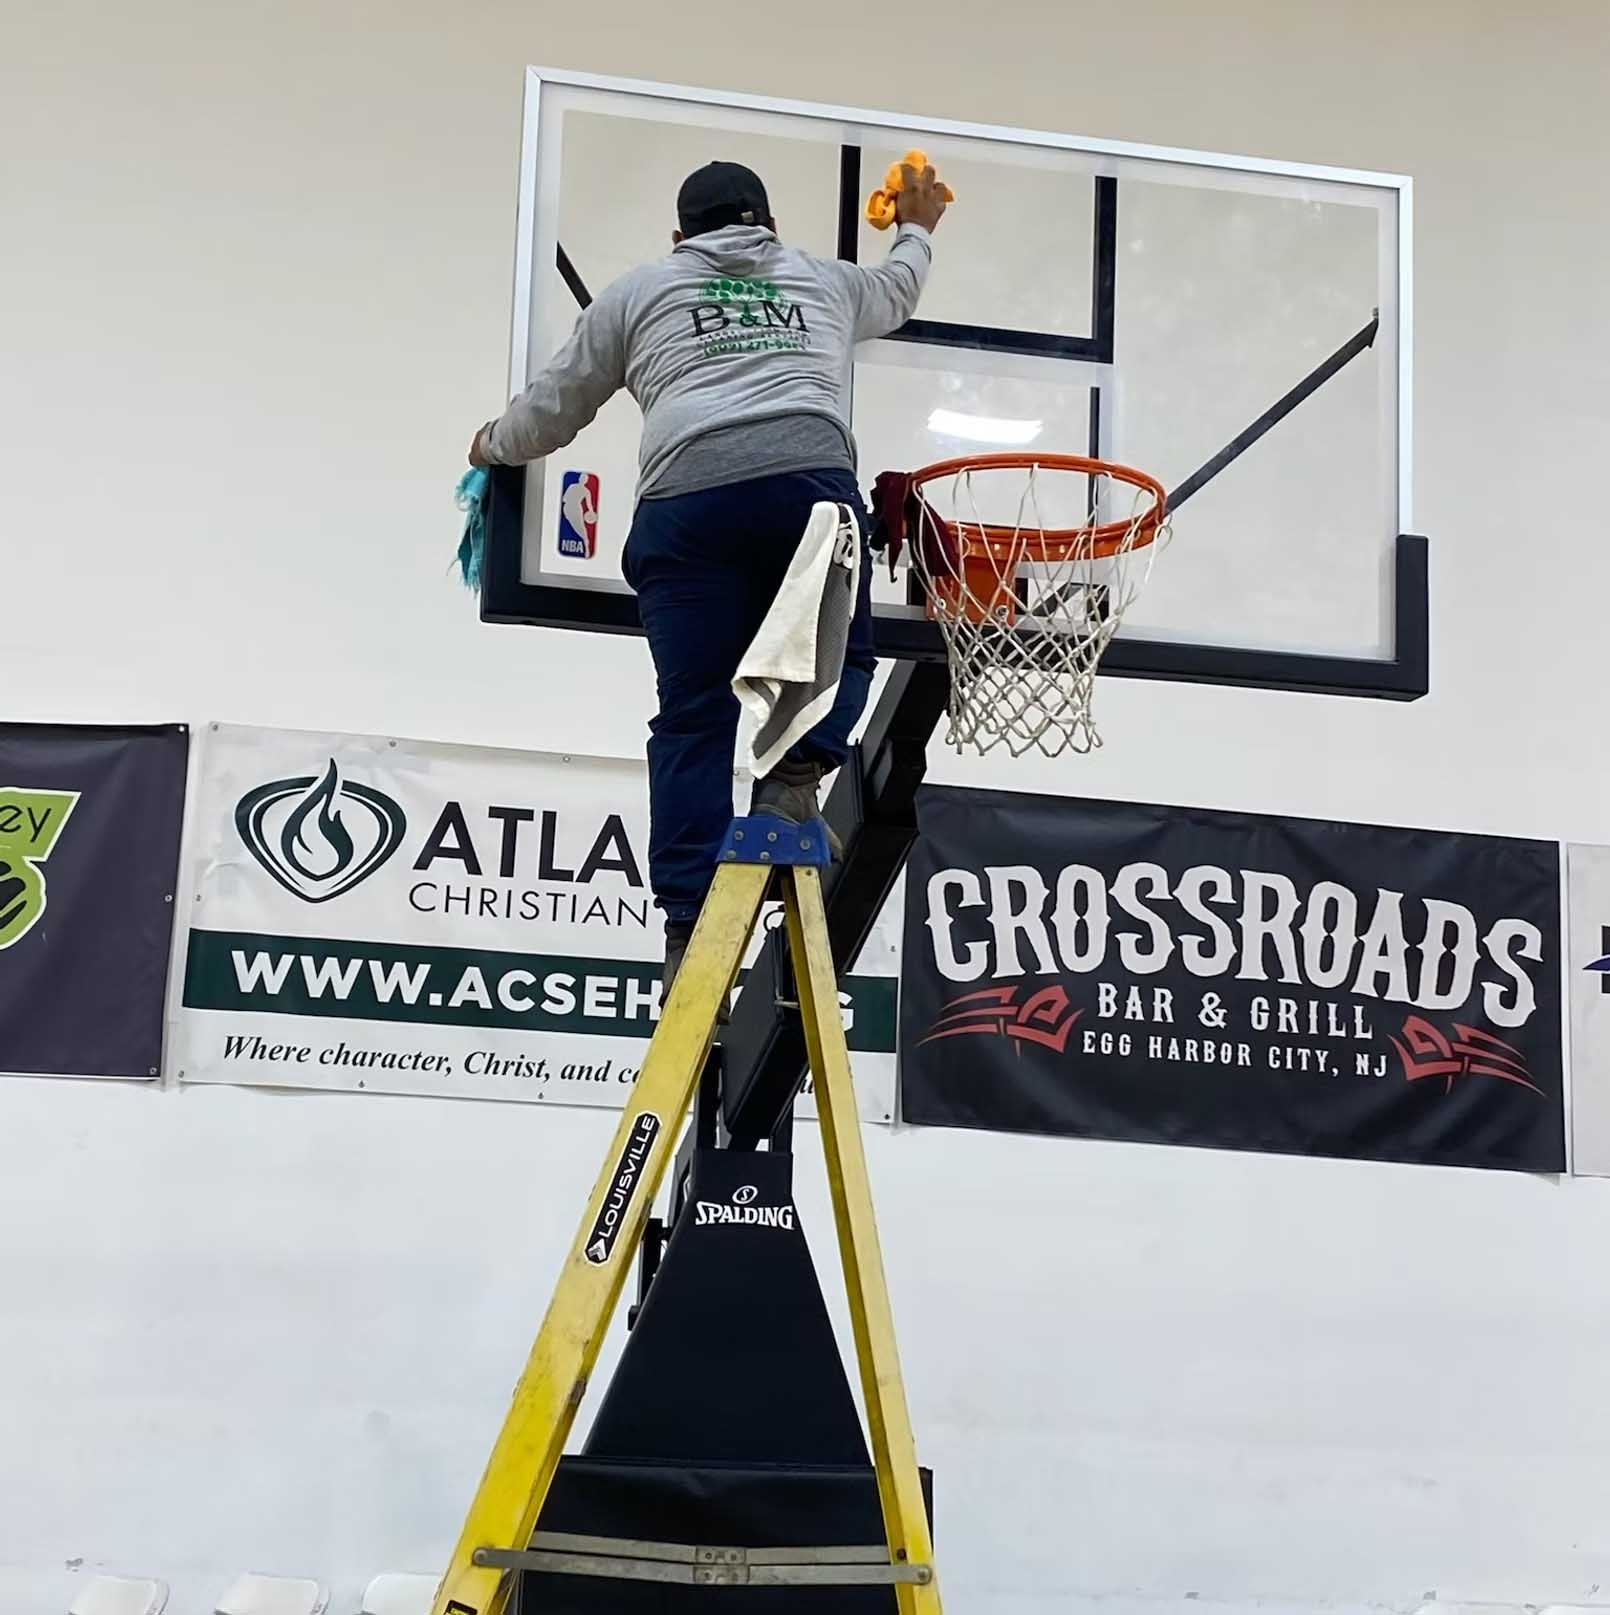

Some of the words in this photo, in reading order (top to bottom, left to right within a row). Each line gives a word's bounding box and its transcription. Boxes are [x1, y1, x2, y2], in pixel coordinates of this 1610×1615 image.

[686, 304, 730, 338] B
[739, 313, 762, 328] &
[758, 300, 810, 333] M
[561, 540, 584, 553] NBA
[409, 882, 648, 928] CHRISTIAN
[924, 862, 1544, 1028] CROSSROADS
[1097, 982, 1175, 1023] BAR
[1198, 991, 1228, 1029] &
[1250, 996, 1373, 1040] GRILL
[223, 1035, 312, 1063] Where
[319, 1042, 452, 1077] character,
[464, 1050, 550, 1083] Christ,
[560, 1060, 613, 1082] and
[1082, 1030, 1133, 1056] EGG
[1148, 1035, 1252, 1067] HARBOR
[1267, 1046, 1339, 1077] CITY,
[1355, 1053, 1387, 1077] NJ
[598, 1115, 656, 1238] LOUISVILLE
[695, 1201, 795, 1231] SPALDING
